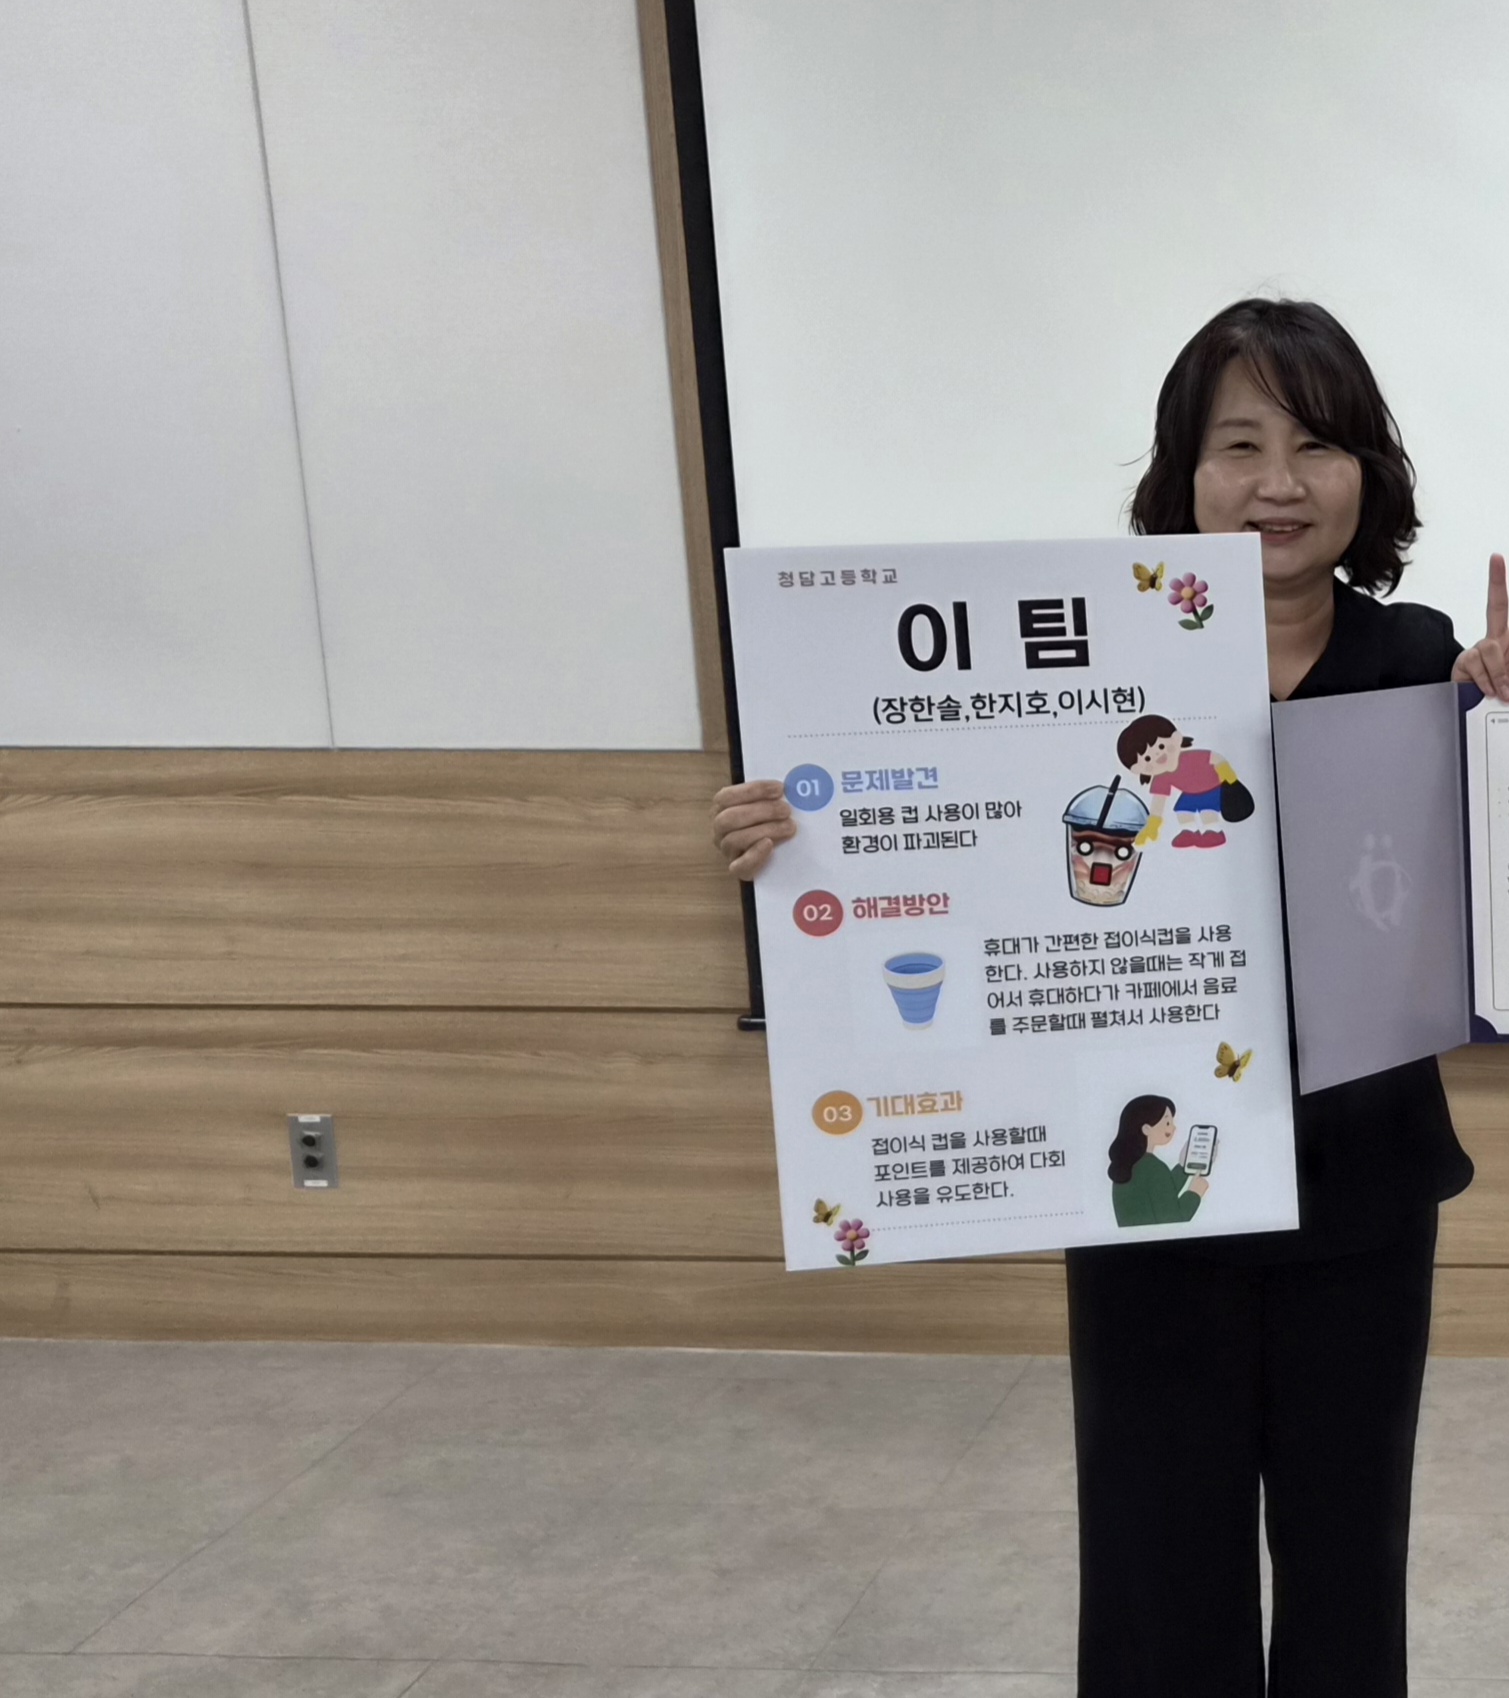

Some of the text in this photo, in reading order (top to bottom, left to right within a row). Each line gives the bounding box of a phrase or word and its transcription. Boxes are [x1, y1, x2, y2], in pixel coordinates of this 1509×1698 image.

[777, 568, 898, 588] 청담고등학교
[897, 597, 1090, 672] 이 팀
[872, 686, 1146, 725] (장한솔,한지호,이시현)
[796, 766, 939, 797] 01 문제발견
[839, 800, 1022, 827] 일회용 컵 사용이 많아
[841, 829, 978, 855] 환경이 파괴된다
[803, 893, 950, 922] 02 해결방안
[983, 924, 1232, 956] 휴대가 간편한 접이식컵을 사용
[985, 949, 1247, 982] 한다. 사용하지 않을때는 작게 접
[987, 976, 1238, 1008] 어서 휴대하다가 카페에서 음료
[989, 1003, 1221, 1035] 를 주문할때 펼쳐서 사용한다
[823, 1090, 964, 1123] 03 기대효과
[871, 1125, 1047, 1156] 접이식 컵을 사용할때
[874, 1150, 1065, 1182] 포인트를 제공하여 다회
[876, 1181, 1015, 1208] 사용을 유도한다.
